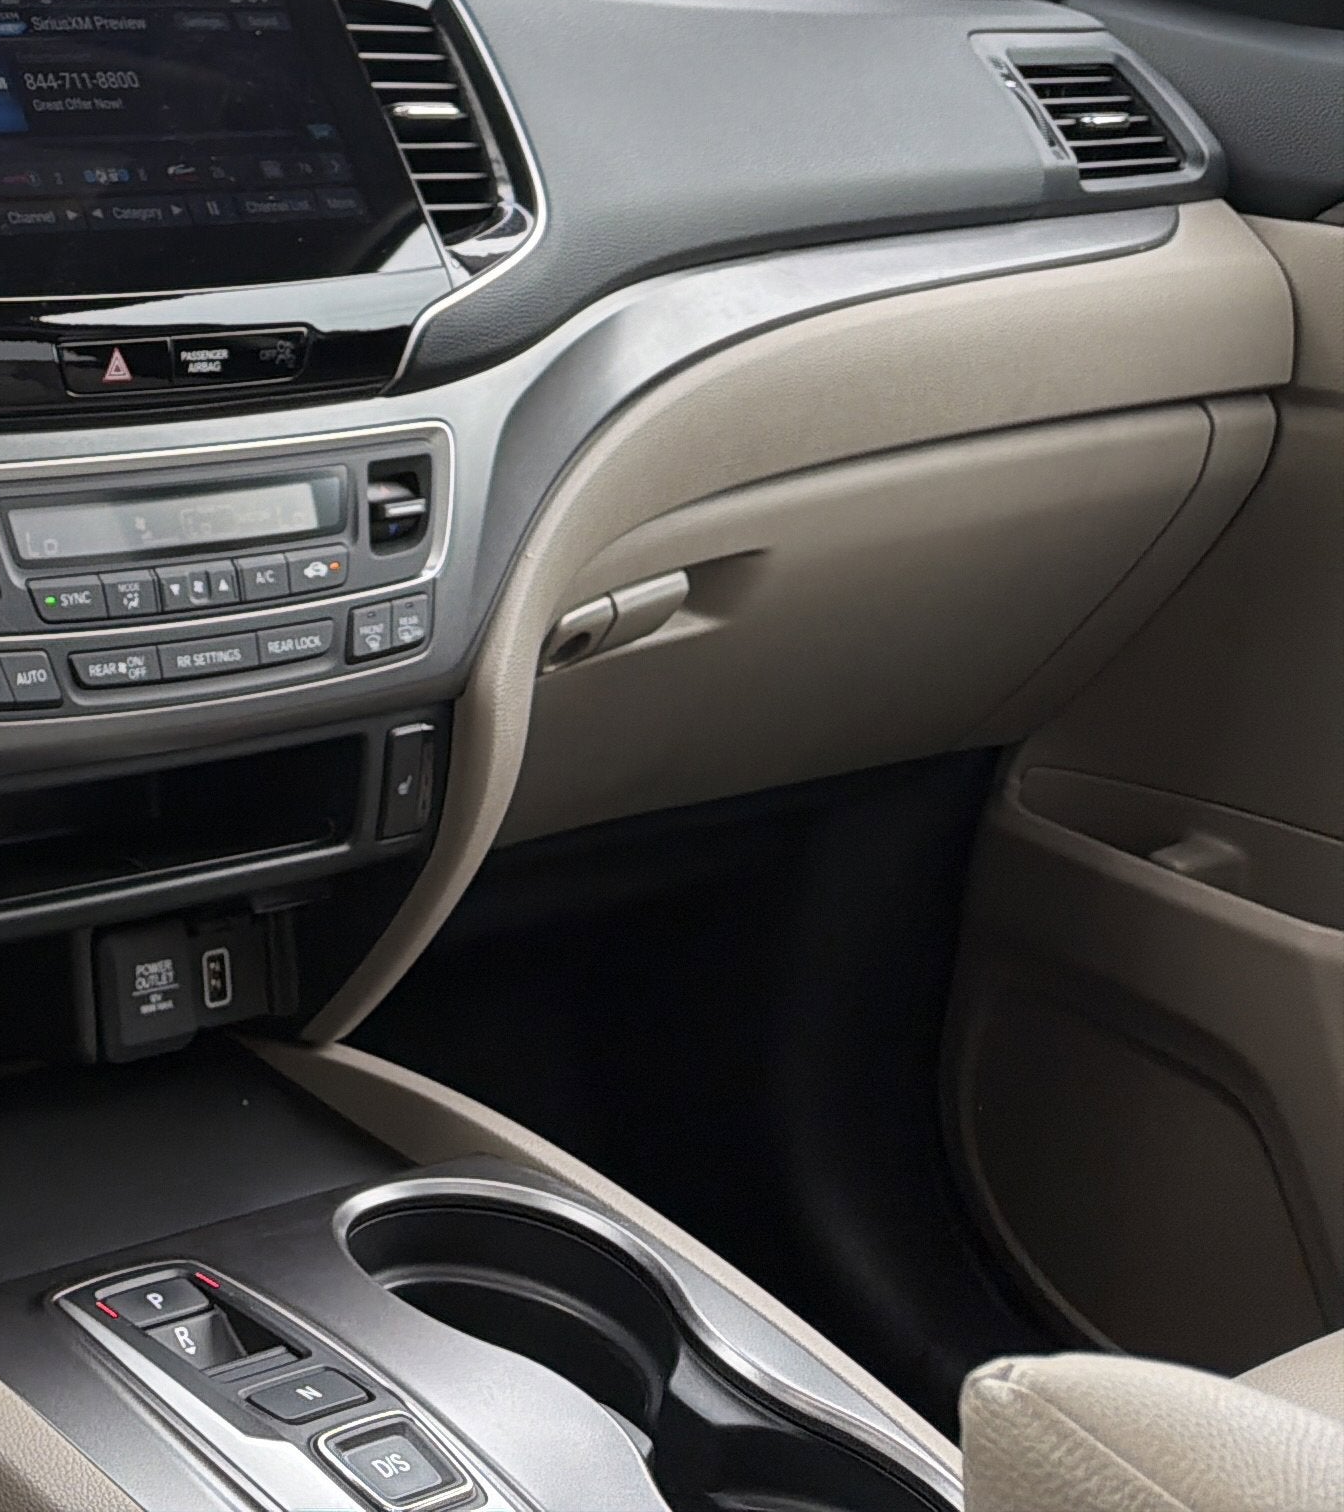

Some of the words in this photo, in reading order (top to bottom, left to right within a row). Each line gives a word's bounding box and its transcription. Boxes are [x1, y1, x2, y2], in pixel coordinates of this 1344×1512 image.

[30, 16, 93, 32] SiriusXM
[94, 16, 148, 31] Preview
[23, 70, 141, 91] 844-711-8800
[7, 211, 56, 225] Channel
[112, 206, 163, 223] Category
[180, 349, 229, 361] PASSENGER
[187, 361, 222, 373] AIRBAG
[255, 570, 275, 585] A/C
[60, 590, 92, 607] SYNC
[267, 639, 294, 655] REAR
[295, 636, 323, 652] LOCK
[177, 654, 191, 669] RR
[192, 648, 242, 668] SETTINGS
[16, 668, 48, 686] AUTO
[88, 662, 118, 678] REAR
[128, 667, 148, 681] OFF
[135, 959, 173, 977] POWER
[135, 971, 175, 990] OUTLET
[145, 1292, 164, 1310] P
[173, 1325, 193, 1347] R
[295, 1384, 323, 1402] N
[371, 1452, 412, 1479] D/S
